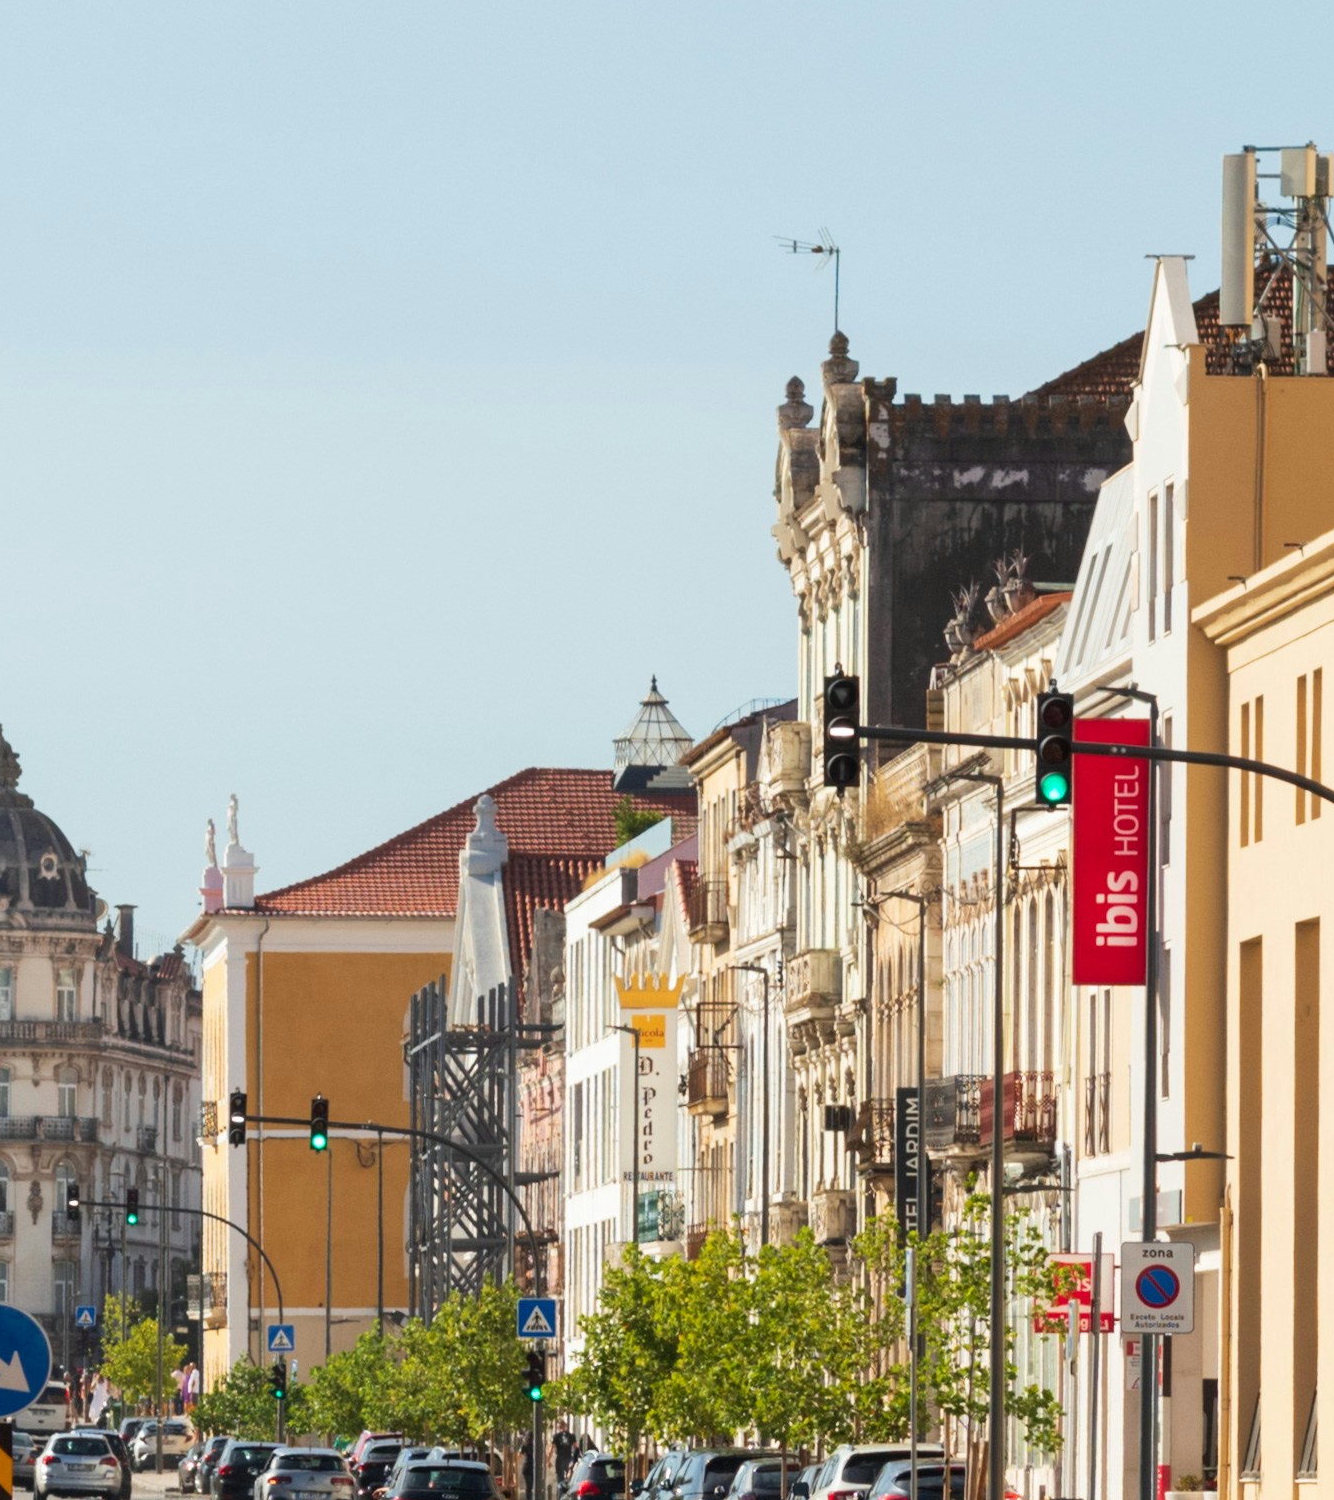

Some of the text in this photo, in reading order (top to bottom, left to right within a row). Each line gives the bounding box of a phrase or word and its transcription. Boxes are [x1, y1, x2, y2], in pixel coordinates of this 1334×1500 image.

[1095, 765, 1140, 947] ibis HOTEL
[637, 1027, 665, 1038] icola
[1142, 1249, 1174, 1258] zona
